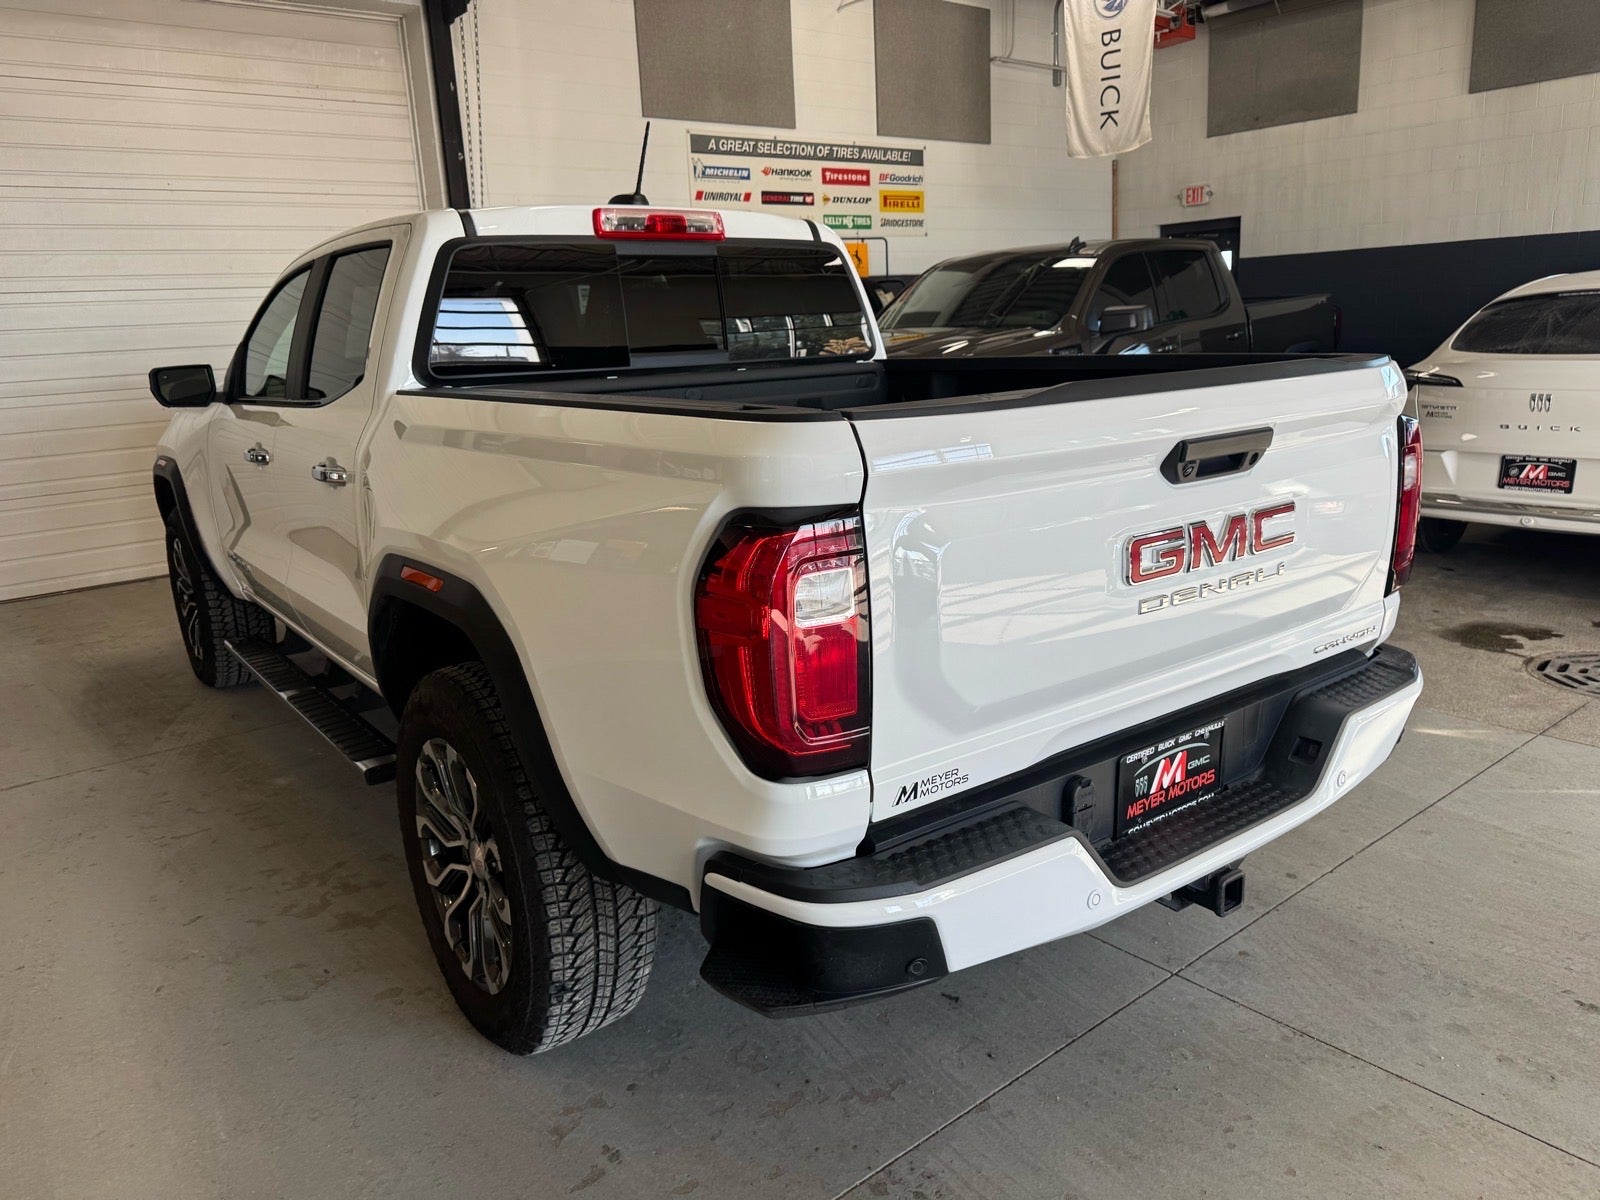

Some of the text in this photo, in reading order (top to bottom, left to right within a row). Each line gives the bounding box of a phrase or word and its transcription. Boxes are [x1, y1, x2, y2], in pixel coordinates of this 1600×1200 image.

[1100, 28, 1121, 130] BUICK
[708, 138, 912, 162] A GREAT SELECTION OF TIRES AVAILABLE!
[704, 167, 749, 178] MICHELIN
[879, 173, 924, 183] BFGoodrich
[704, 191, 742, 202] UNIROYAL
[832, 196, 872, 204] DUNLOP
[883, 194, 921, 208] PIRELLI
[1185, 186, 1205, 204] EXIT
[880, 218, 924, 228] BRIDGESTONE
[1500, 424, 1581, 432] BUICK
[1503, 477, 1570, 488] MEYER MOTORS
[1123, 500, 1296, 586] GMC
[1138, 561, 1286, 615] DENALI
[1312, 624, 1377, 655] CANYON
[1126, 746, 1155, 764] CERTIFIED
[1158, 738, 1175, 752] BUICK
[1178, 732, 1193, 744] GMC
[1187, 754, 1211, 770] GMC
[920, 768, 959, 788] MEYER
[920, 774, 969, 798] MOTORS
[1126, 768, 1216, 820] MEYER MOTORS
